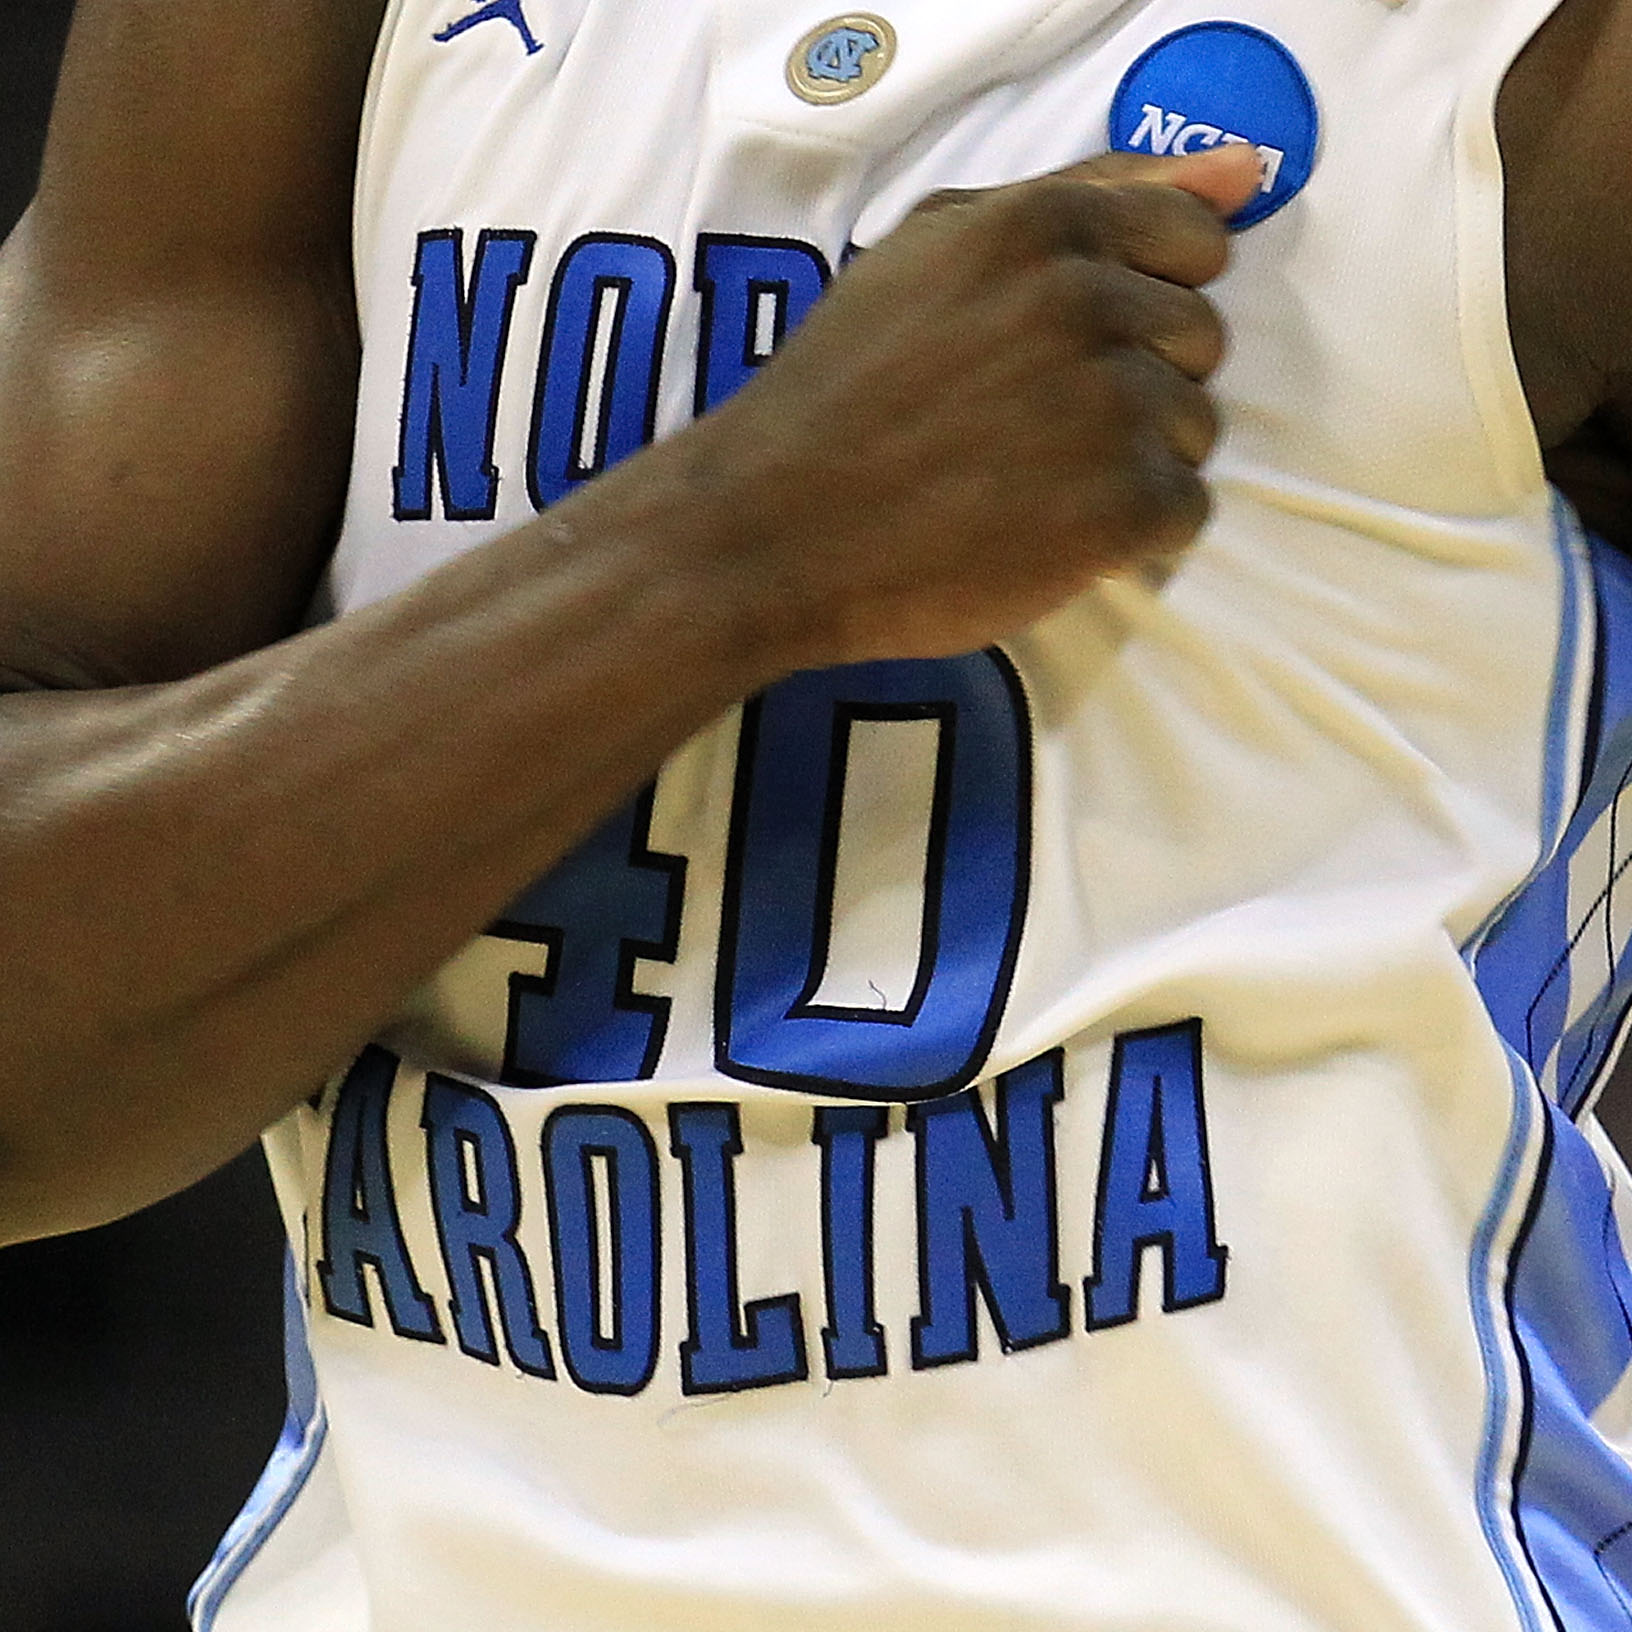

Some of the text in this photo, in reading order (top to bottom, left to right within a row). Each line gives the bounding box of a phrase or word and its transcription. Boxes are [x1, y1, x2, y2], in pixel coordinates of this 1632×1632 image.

[1128, 103, 1285, 194] NCA
[392, 228, 864, 521] NOR
[480, 644, 1033, 1104] 40
[310, 1017, 1229, 1396] AROLINA
